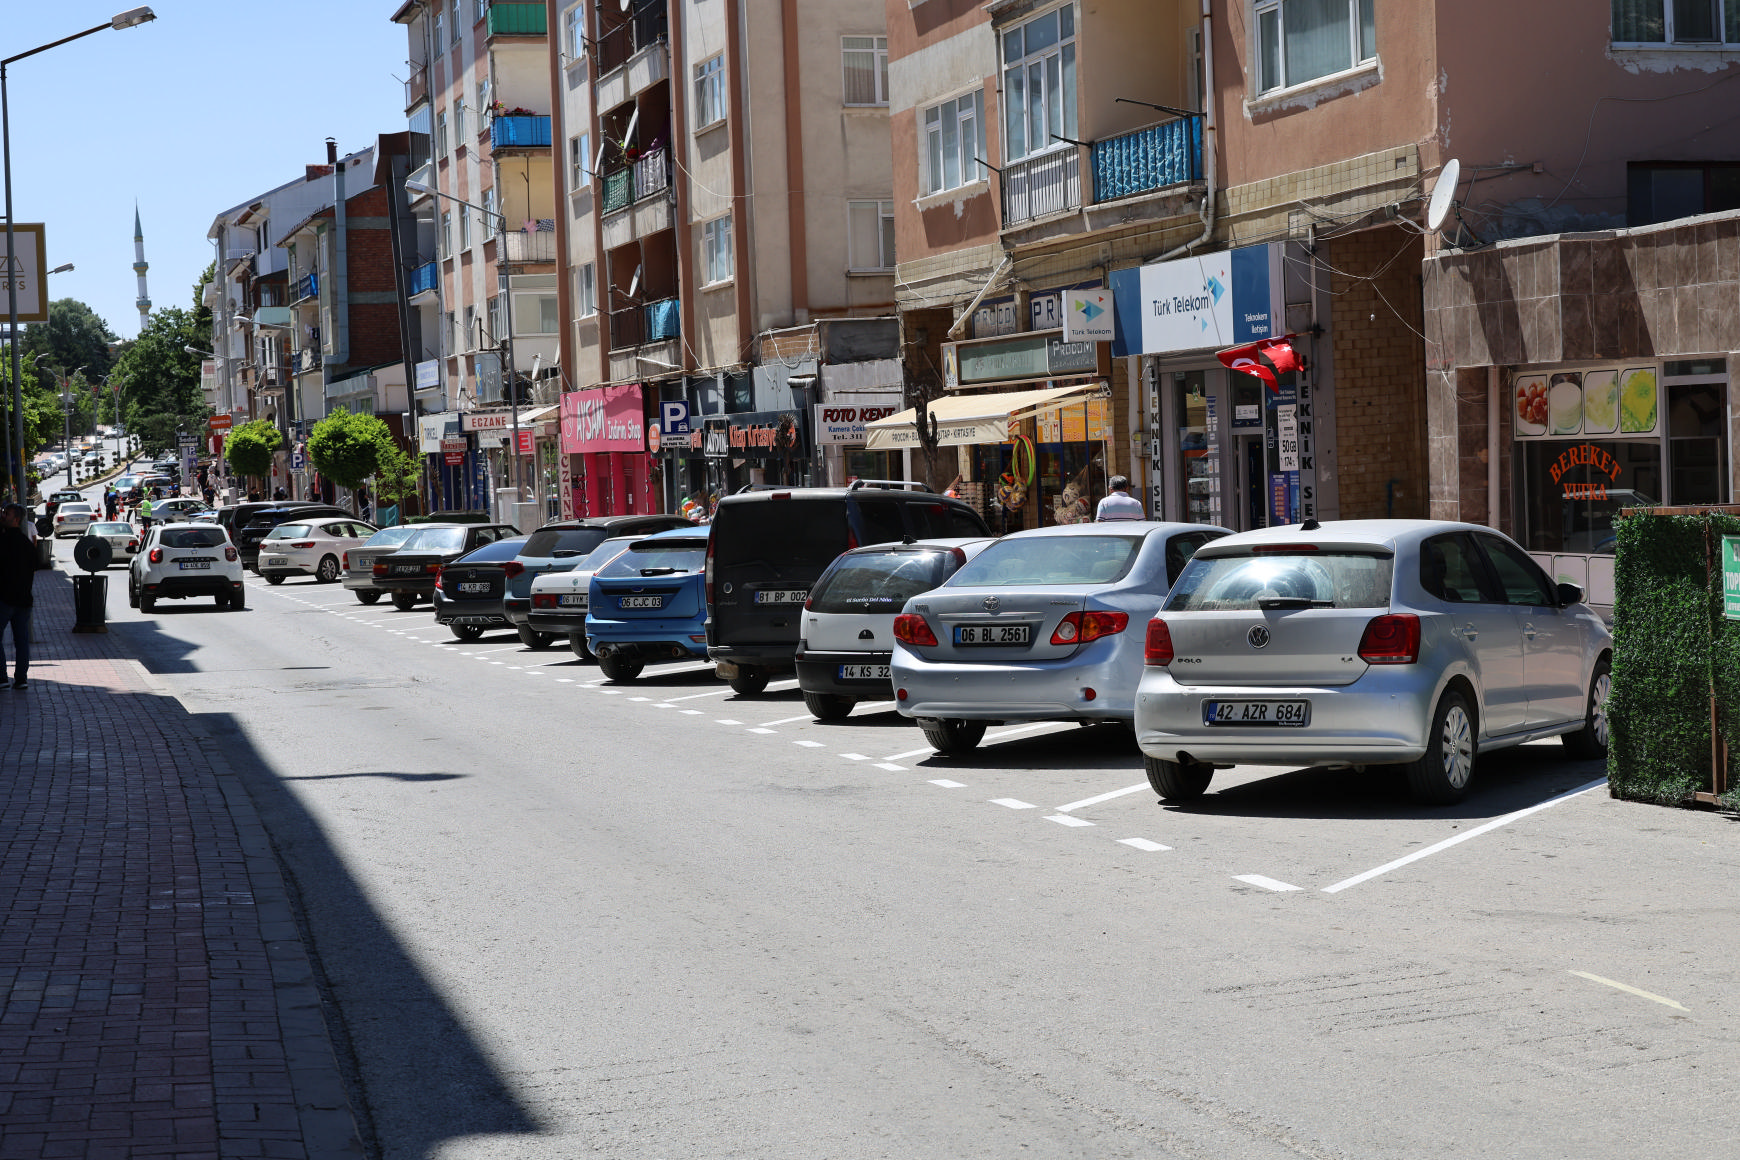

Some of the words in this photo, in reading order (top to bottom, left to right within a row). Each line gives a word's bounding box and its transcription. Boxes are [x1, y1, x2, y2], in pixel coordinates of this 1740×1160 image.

[1153, 300, 1171, 316] Türk
[1173, 295, 1209, 313] Telekom
[471, 416, 506, 428] ECZANE
[664, 403, 687, 433] P
[822, 408, 857, 422] FOTO
[292, 454, 303, 467] P
[1549, 445, 1622, 485] BEREKET
[561, 456, 572, 520] CZANE
[1563, 483, 1608, 500] YUFKA
[1725, 571, 1740, 590] TOP
[621, 598, 631, 607] 06
[758, 593, 770, 602] 81
[774, 593, 786, 602] BP
[962, 629, 975, 642] 06
[981, 629, 995, 642] BL
[1000, 628, 1027, 642] 2561
[844, 666, 855, 678] 14
[860, 666, 872, 678] KS
[878, 666, 892, 678] 32
[1217, 705, 1233, 720] 42
[1241, 705, 1268, 720] AZR
[1275, 705, 1302, 720] 684
